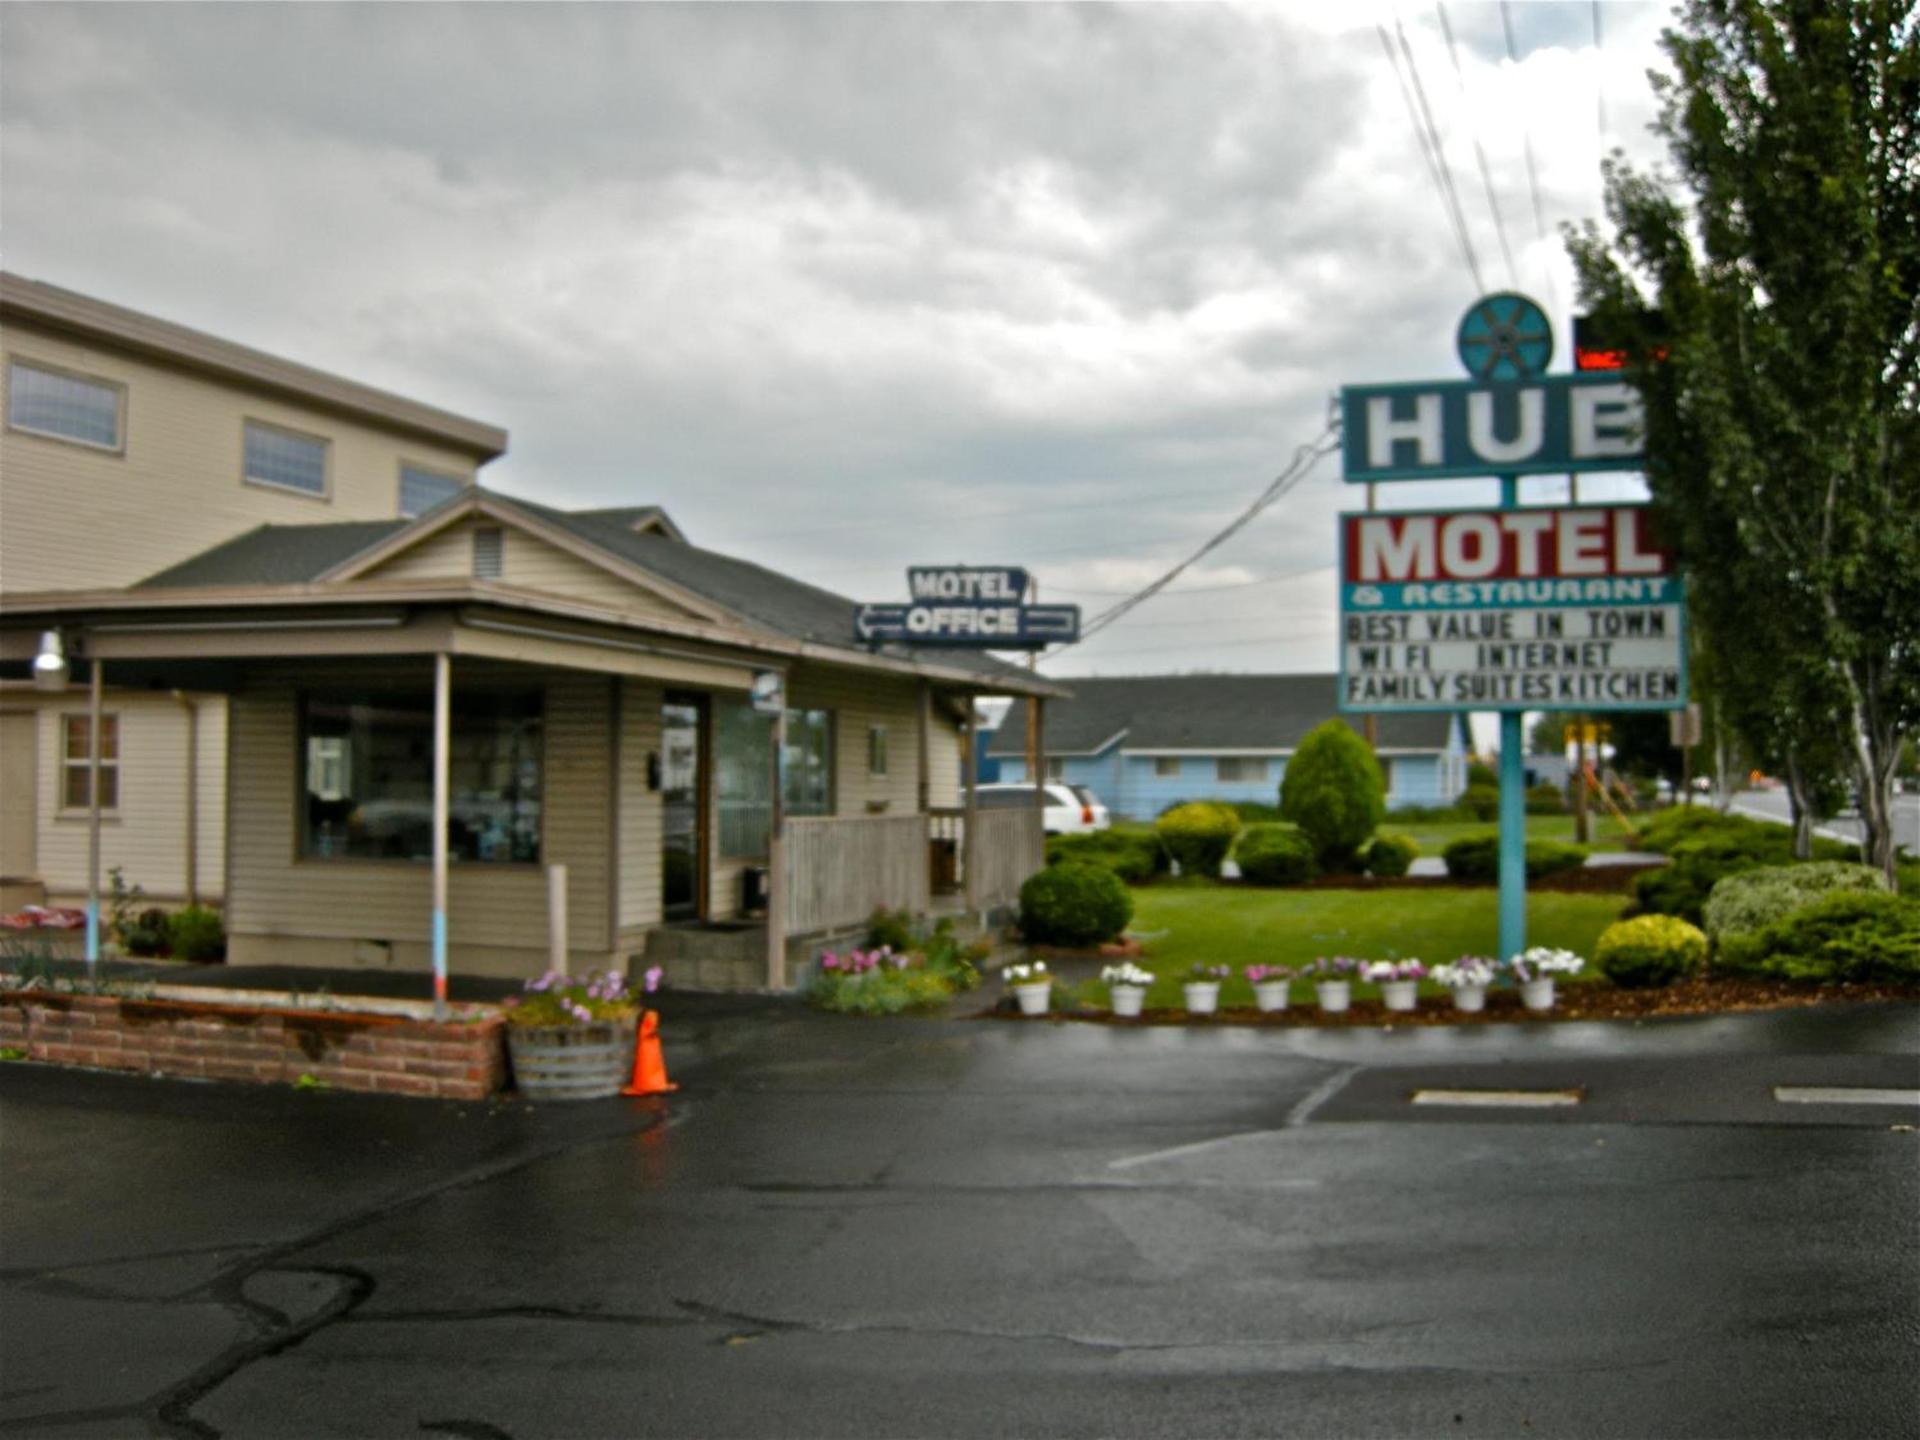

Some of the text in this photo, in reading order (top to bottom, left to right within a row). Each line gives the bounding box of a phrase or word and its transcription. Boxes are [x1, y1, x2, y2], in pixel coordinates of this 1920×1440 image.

[1359, 509, 1664, 581] MOTEL
[913, 571, 1017, 600] MOTEL
[1353, 578, 1667, 606] & RESTAURANT
[906, 606, 1019, 635] OFFICE
[1348, 610, 1665, 642] BEST VALUE IN TOWN
[1478, 641, 1614, 670] INTERNET
[1348, 670, 1679, 703] FAMILY SUITES KITCHEN
